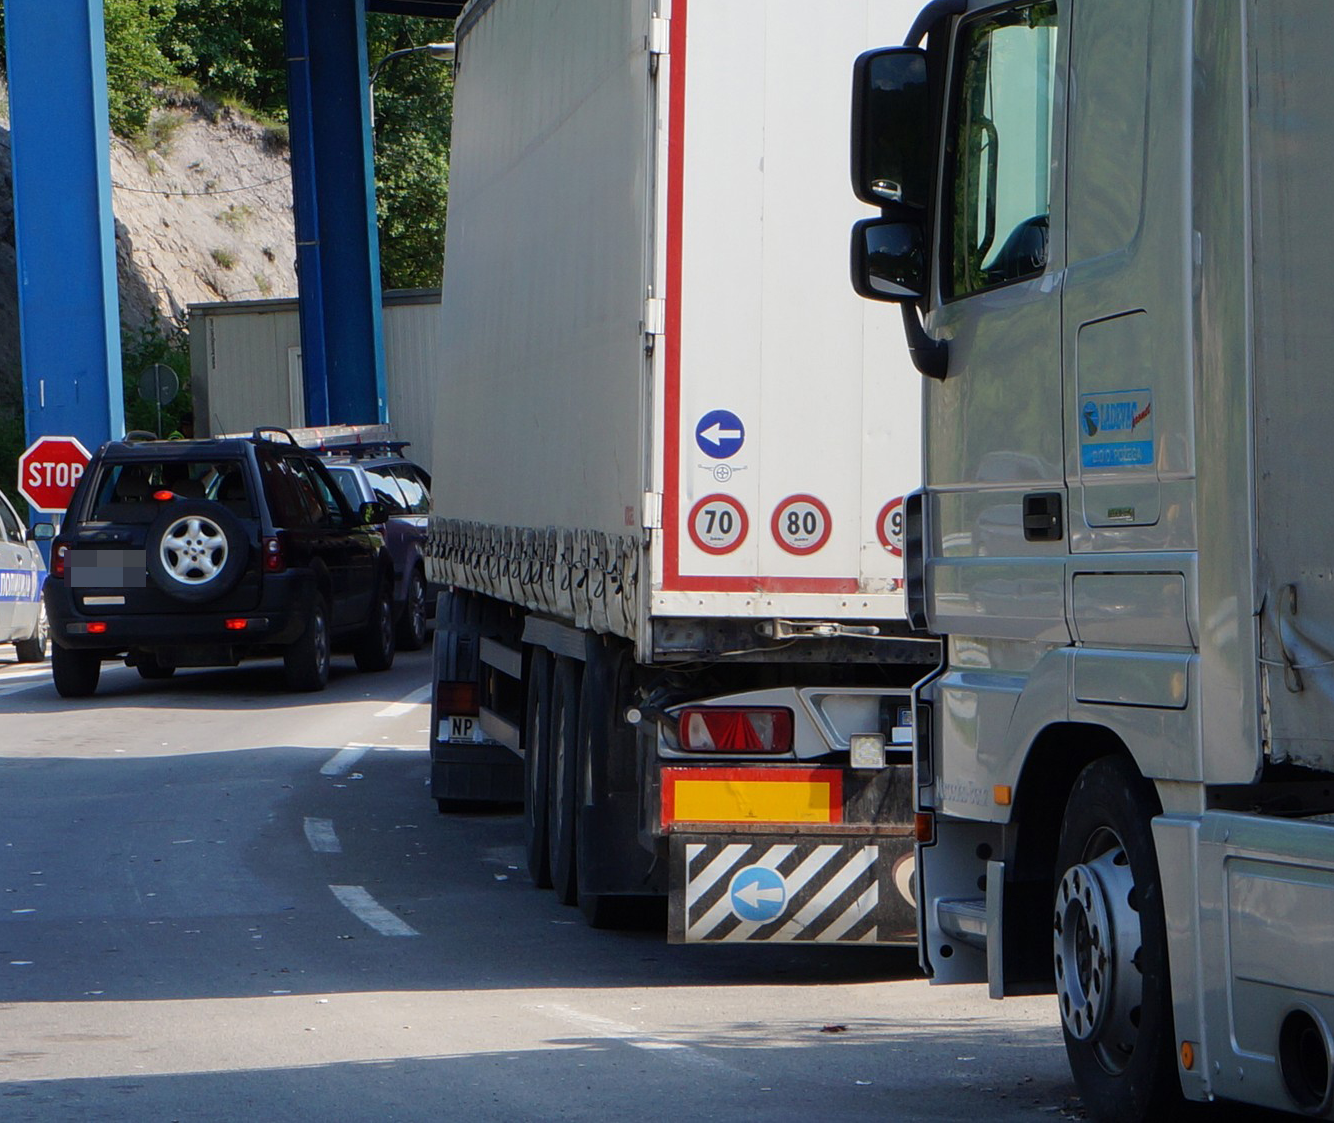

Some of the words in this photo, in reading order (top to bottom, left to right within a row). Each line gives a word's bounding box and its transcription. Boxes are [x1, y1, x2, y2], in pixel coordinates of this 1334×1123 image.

[28, 462, 84, 488] STOP
[704, 509, 733, 534] 70
[787, 511, 817, 535] 80
[452, 717, 473, 737] NP
